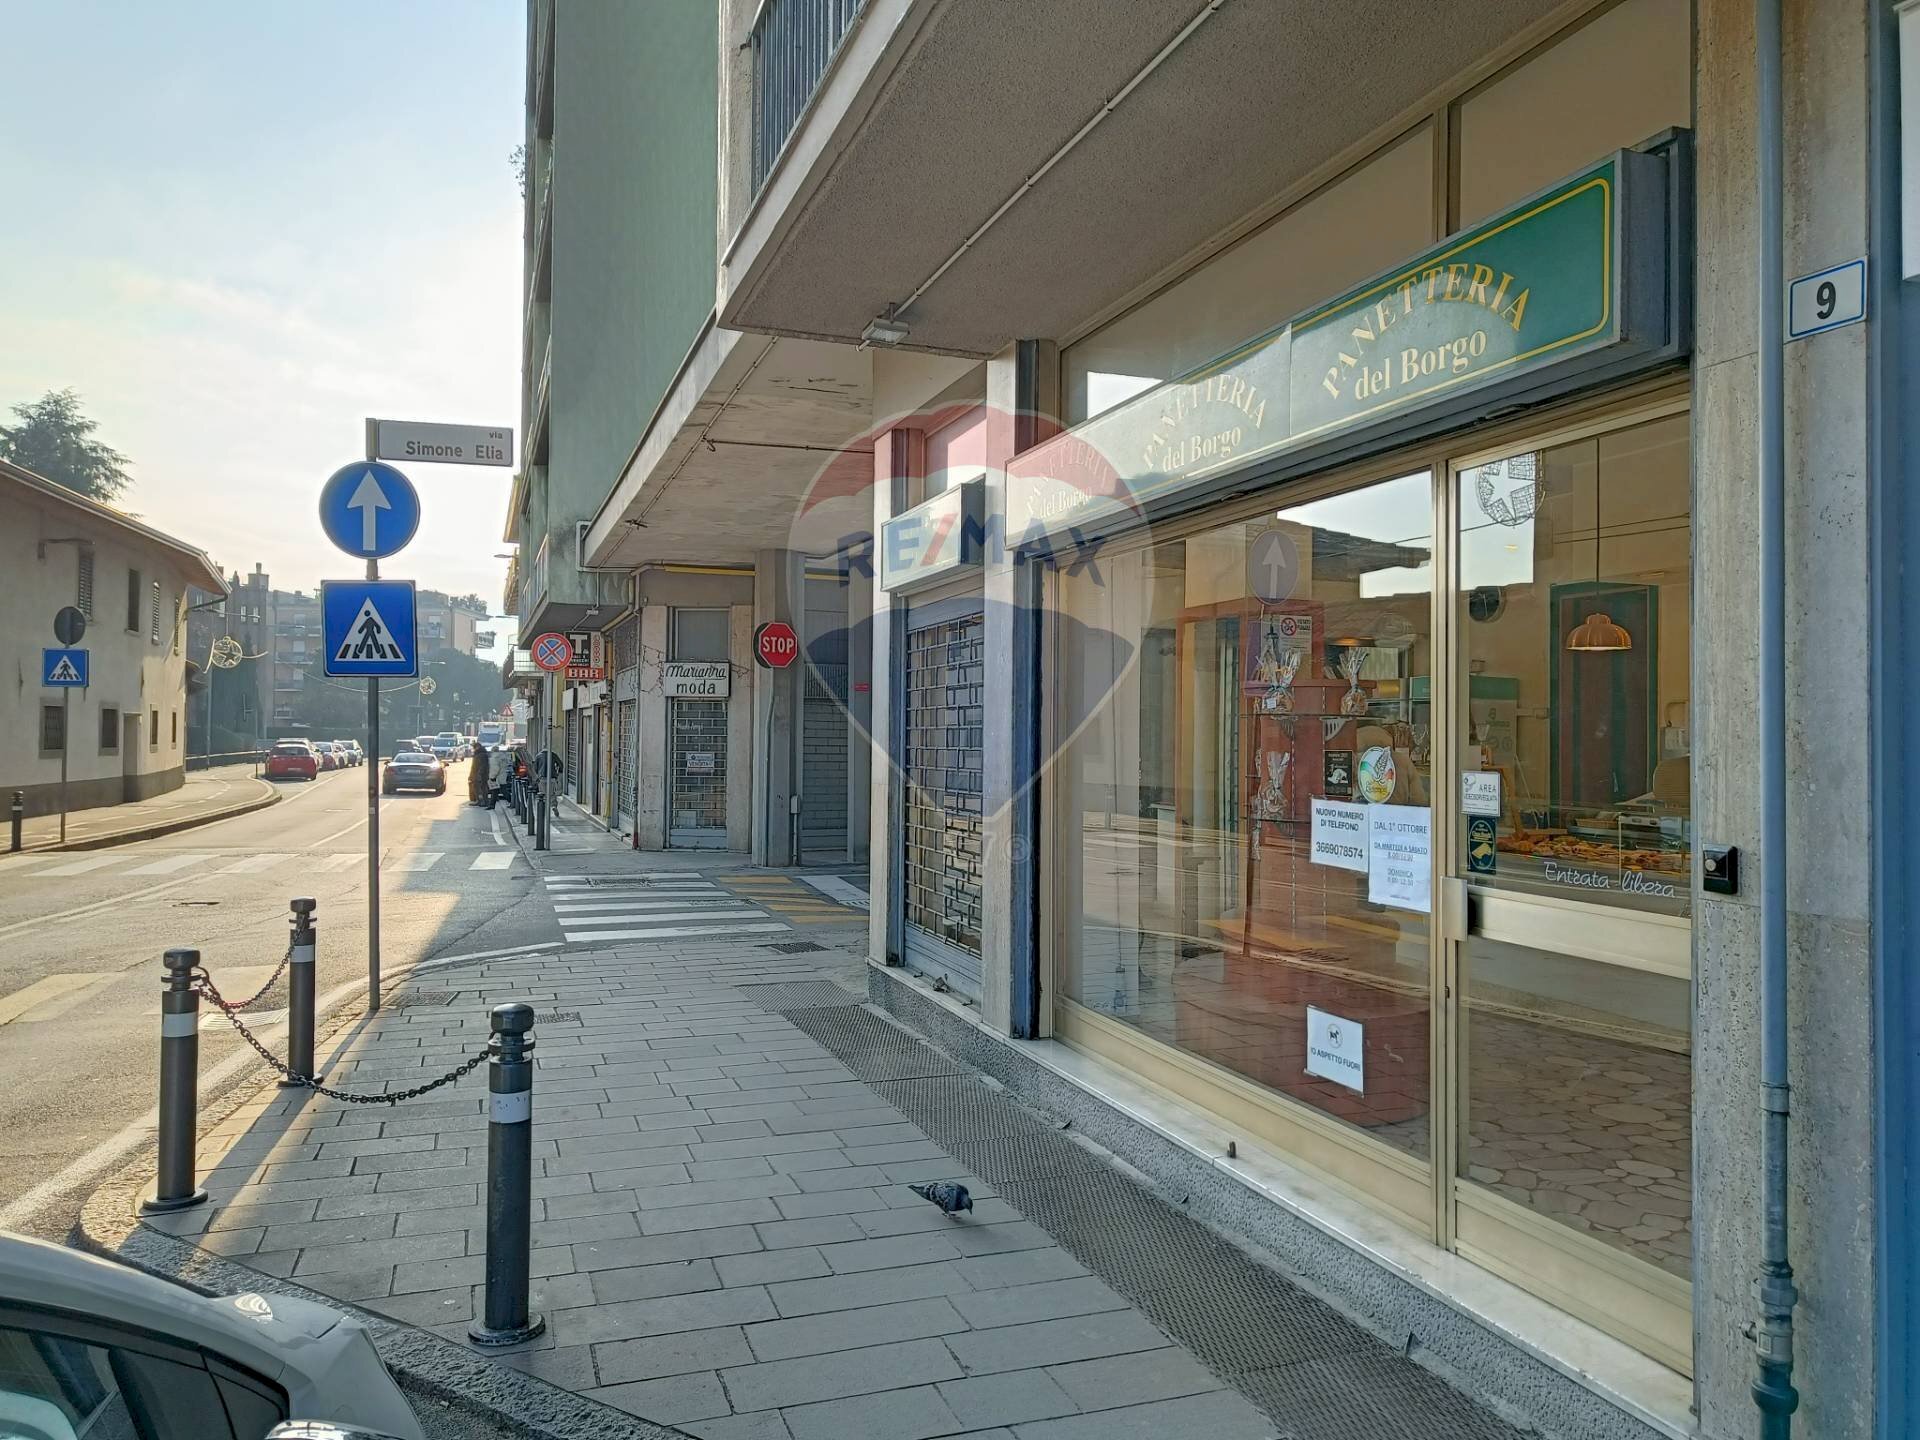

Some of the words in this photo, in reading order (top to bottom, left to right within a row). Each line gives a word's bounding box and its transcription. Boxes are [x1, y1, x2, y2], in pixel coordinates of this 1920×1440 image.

[1816, 281, 1837, 320] 9
[1321, 263, 1530, 399] PANETTERIA
[1354, 358, 1391, 400] del
[1401, 329, 1488, 385] Borgo
[1142, 374, 1268, 470] PANETTERIA
[489, 431, 503, 440] via
[405, 440, 463, 457] Simone
[475, 444, 503, 460] Elia
[1162, 445, 1185, 473] del
[1191, 426, 1241, 458] Borgo
[762, 636, 795, 654] STOP
[568, 668, 599, 678] BAR
[665, 664, 727, 680] Marianna
[676, 679, 716, 695] moda
[1478, 784, 1497, 793] AREA
[1315, 807, 1337, 818] NUOVO
[1337, 810, 1364, 821] NUMERO
[1320, 819, 1327, 827] DI
[1327, 819, 1359, 832] TELEFONO
[1374, 820, 1388, 830] DAL
[1397, 823, 1428, 834] OTTOBRE
[1543, 861, 1611, 889] Entrata
[1621, 870, 1676, 898] libera
[1310, 1046, 1317, 1056] IO
[1317, 1049, 1343, 1064] ASPETTO
[1342, 1058, 1361, 1072] FUORI
